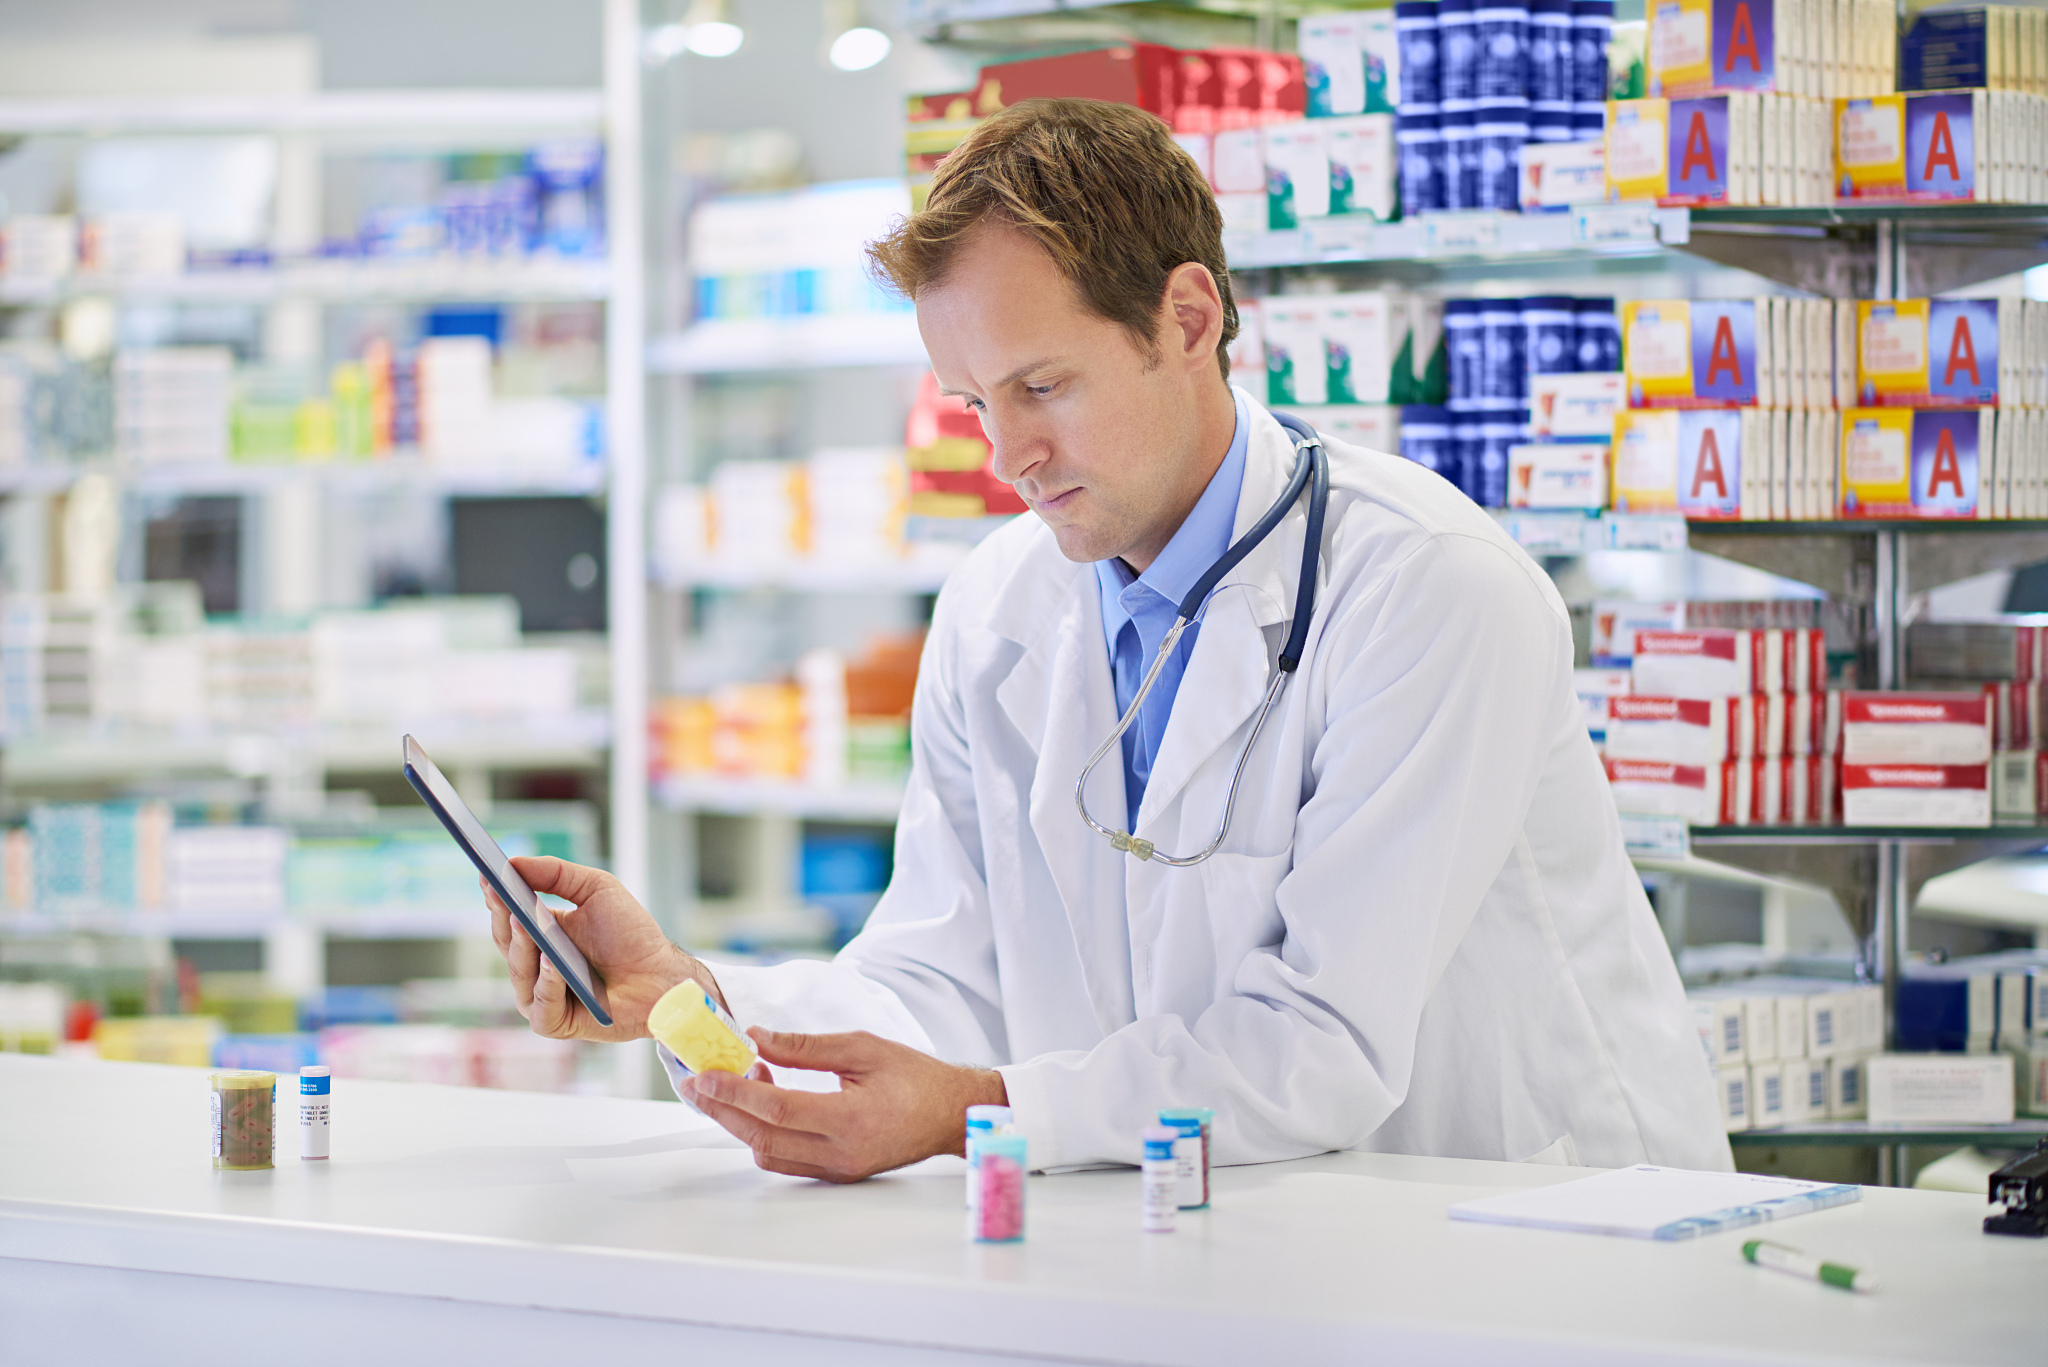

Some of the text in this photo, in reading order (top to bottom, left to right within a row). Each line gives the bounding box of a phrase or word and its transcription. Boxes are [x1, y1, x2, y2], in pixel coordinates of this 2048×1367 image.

[1724, 2, 1761, 72] A
[1680, 111, 1717, 181] A
[1923, 111, 1960, 181] A
[1706, 316, 1743, 386] A
[1944, 316, 1980, 386] A
[1691, 428, 1727, 498] A
[1927, 428, 1964, 498] A
